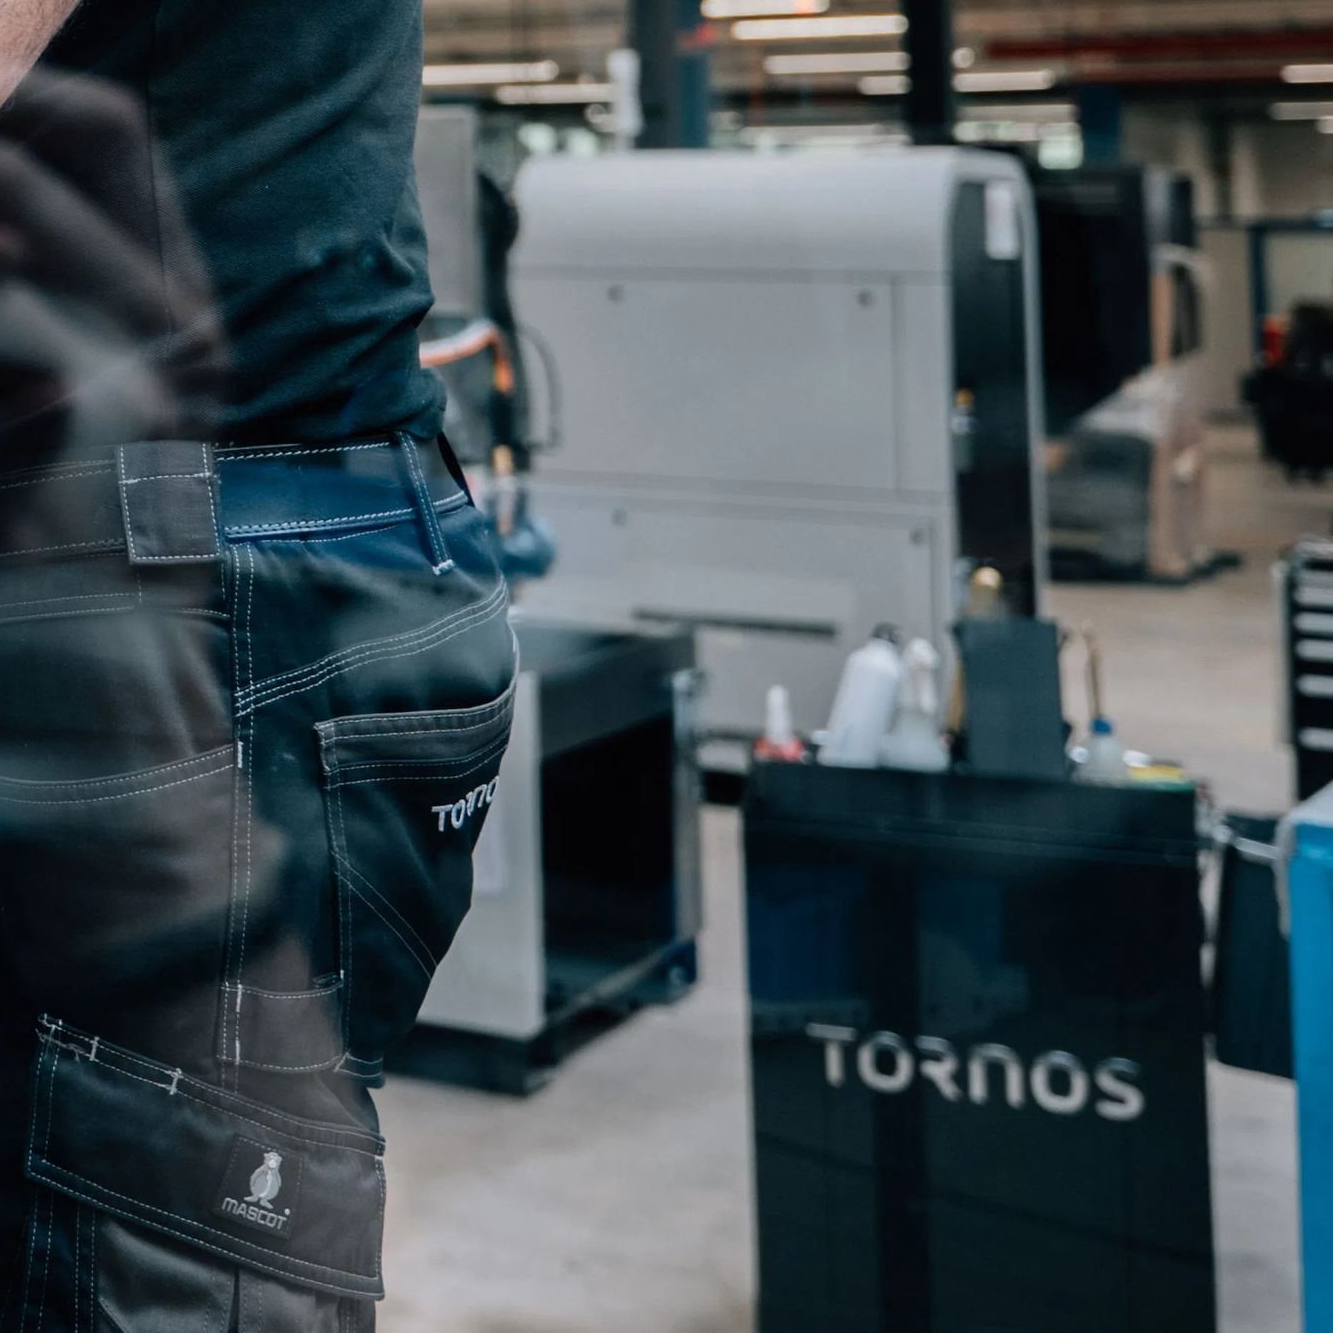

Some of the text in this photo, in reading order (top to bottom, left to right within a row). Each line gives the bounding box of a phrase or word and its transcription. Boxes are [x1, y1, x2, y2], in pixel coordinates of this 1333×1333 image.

[431, 775, 500, 832] TORNO
[805, 1022, 1145, 1122] TORNOS
[221, 1197, 287, 1230] MASCOT
